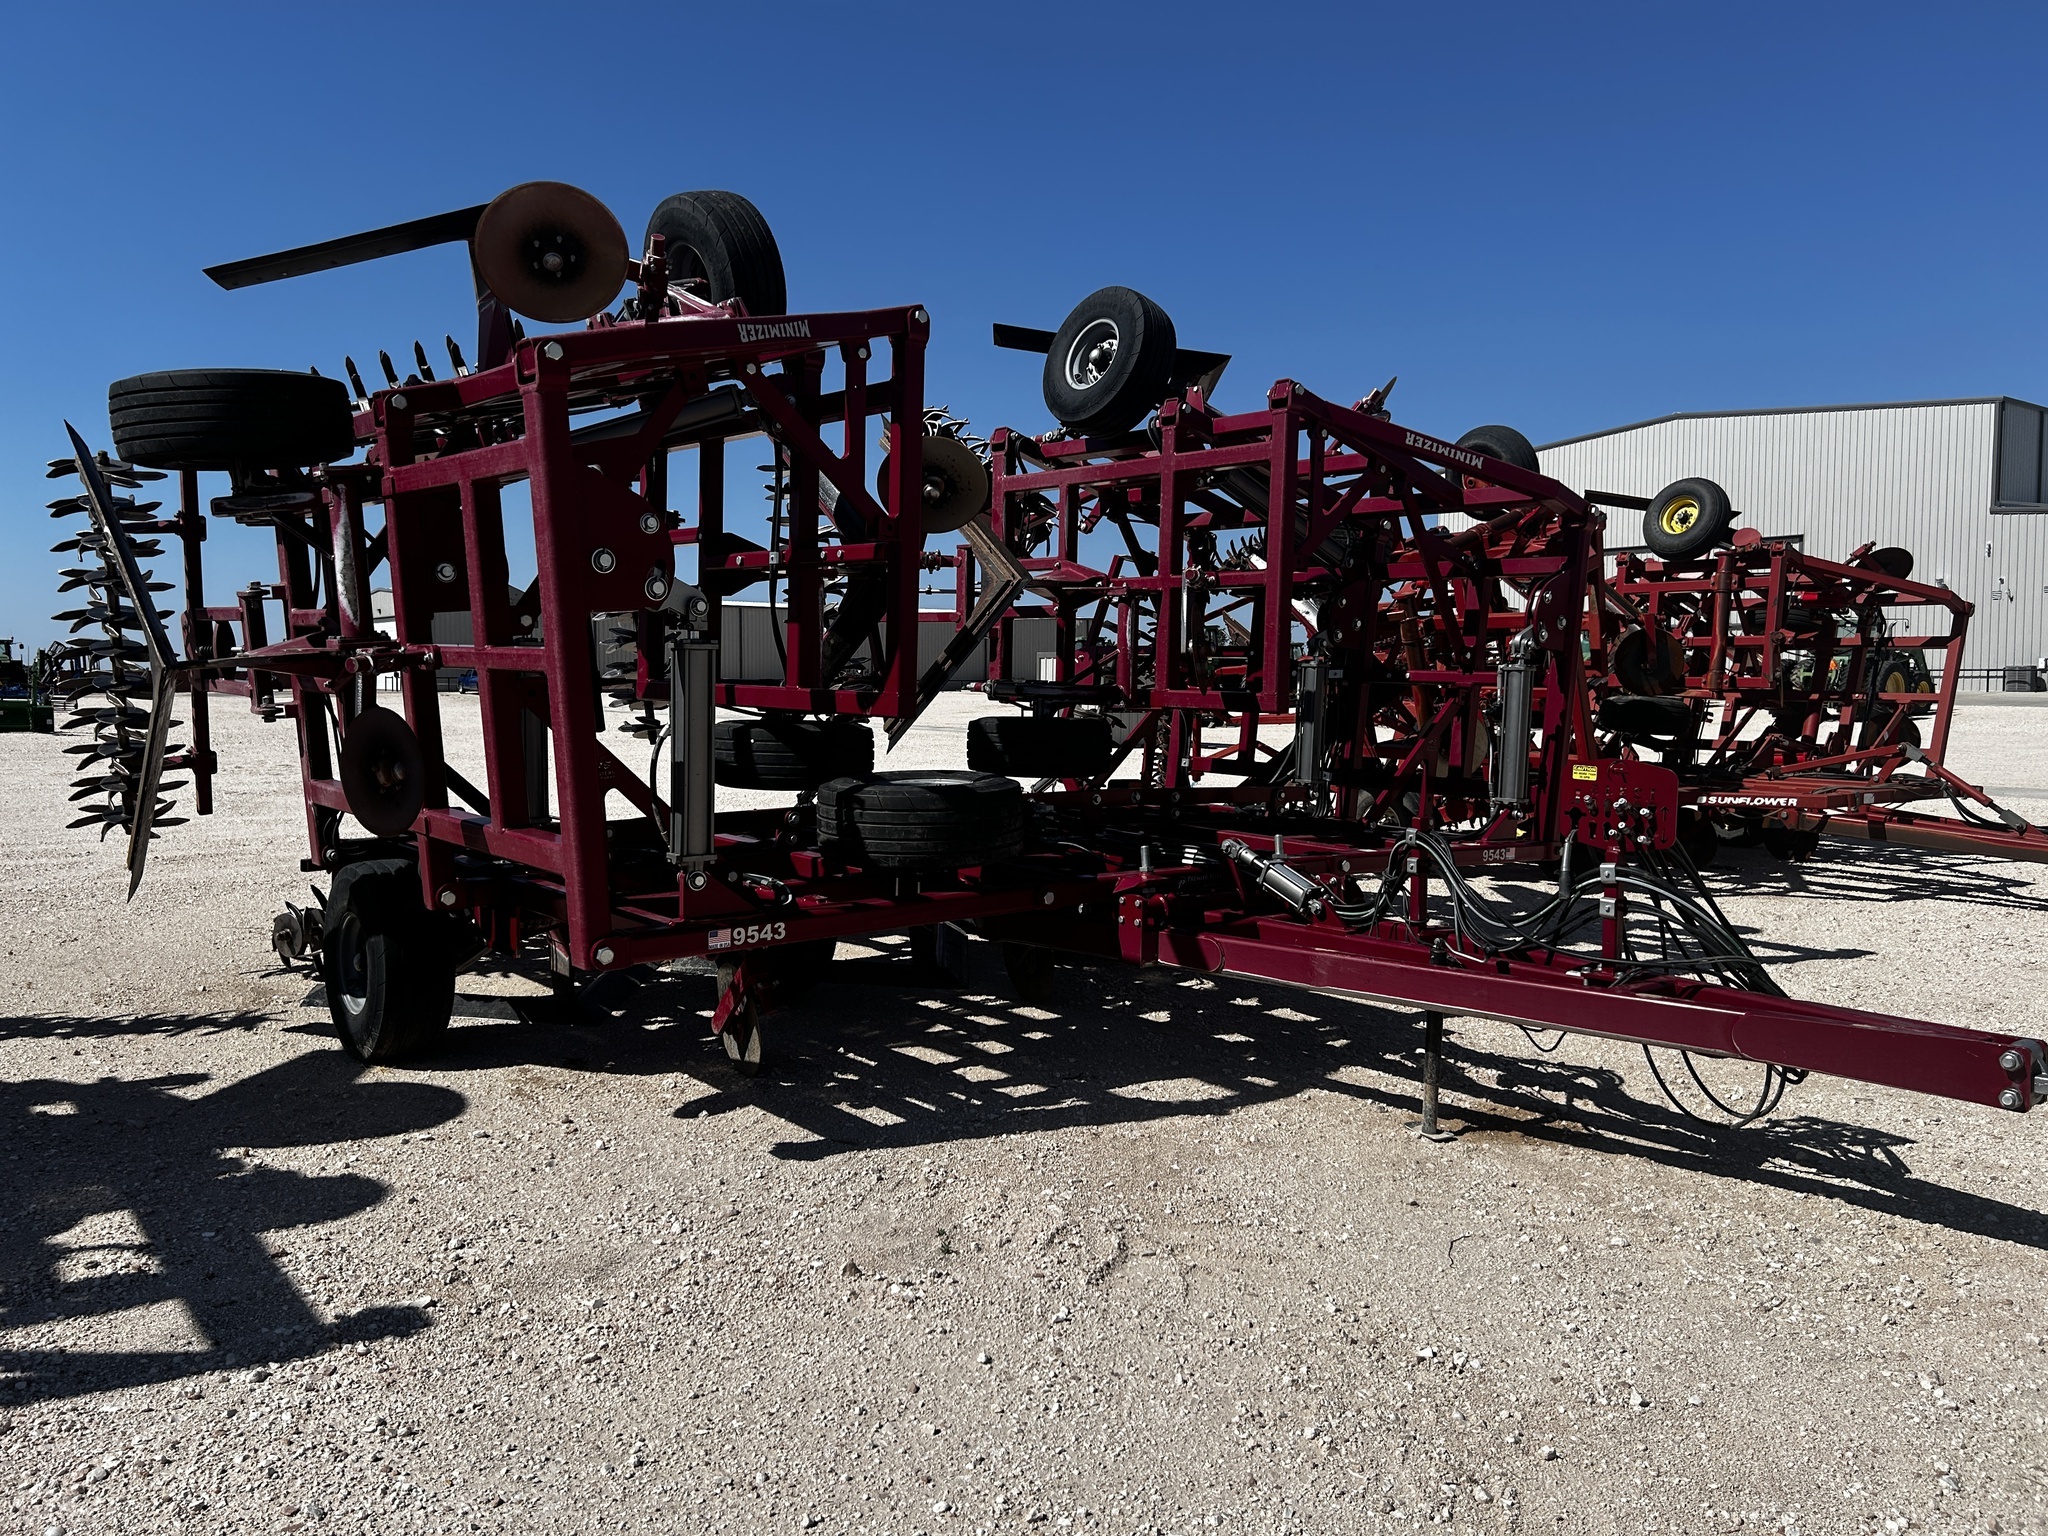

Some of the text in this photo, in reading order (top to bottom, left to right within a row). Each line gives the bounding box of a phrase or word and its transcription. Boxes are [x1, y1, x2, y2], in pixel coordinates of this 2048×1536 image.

[737, 319, 811, 343] MINIMIZER
[1405, 432, 1484, 470] MINIMIZER
[1707, 796, 1798, 807] SUNFLOWER
[1482, 848, 1506, 861] 9543
[733, 922, 786, 945] 9543
